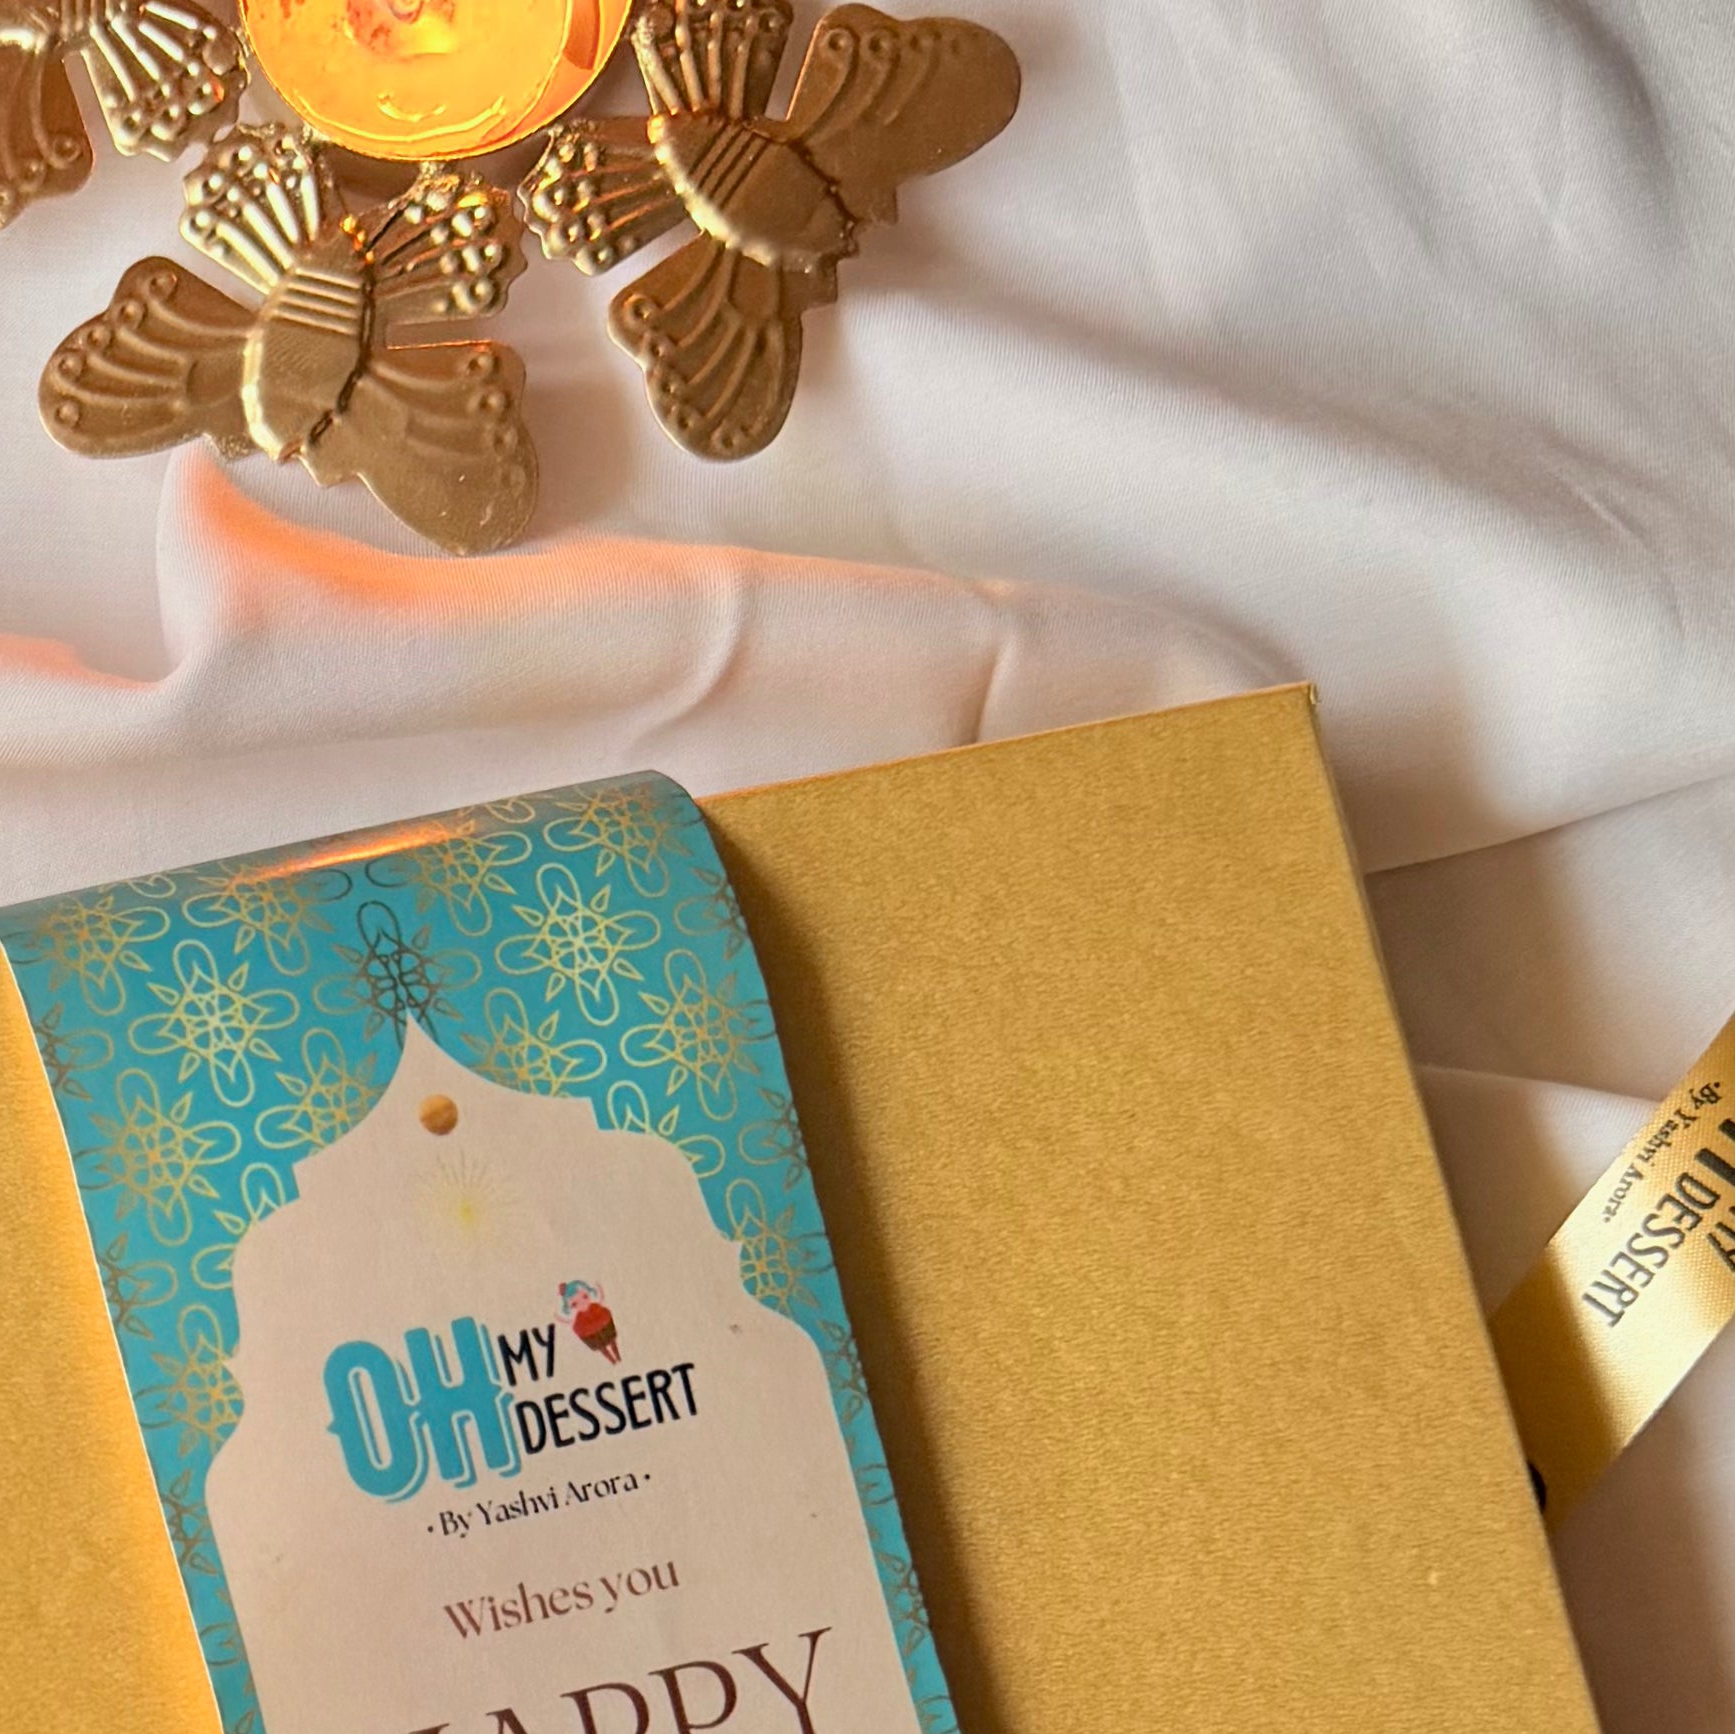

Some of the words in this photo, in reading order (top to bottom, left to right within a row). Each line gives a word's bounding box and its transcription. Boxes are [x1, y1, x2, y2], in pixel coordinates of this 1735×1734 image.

[1636, 1109, 1699, 1167] Yashvi
[1582, 1172, 1721, 1328] DESSERT
[323, 1316, 522, 1505] OH
[497, 1323, 555, 1386] MY
[515, 1363, 697, 1454] DESSERT
[476, 1486, 559, 1526] Yashvi
[565, 1473, 638, 1506] Arora
[444, 1581, 594, 1639] Wishes
[600, 1561, 680, 1613] you
